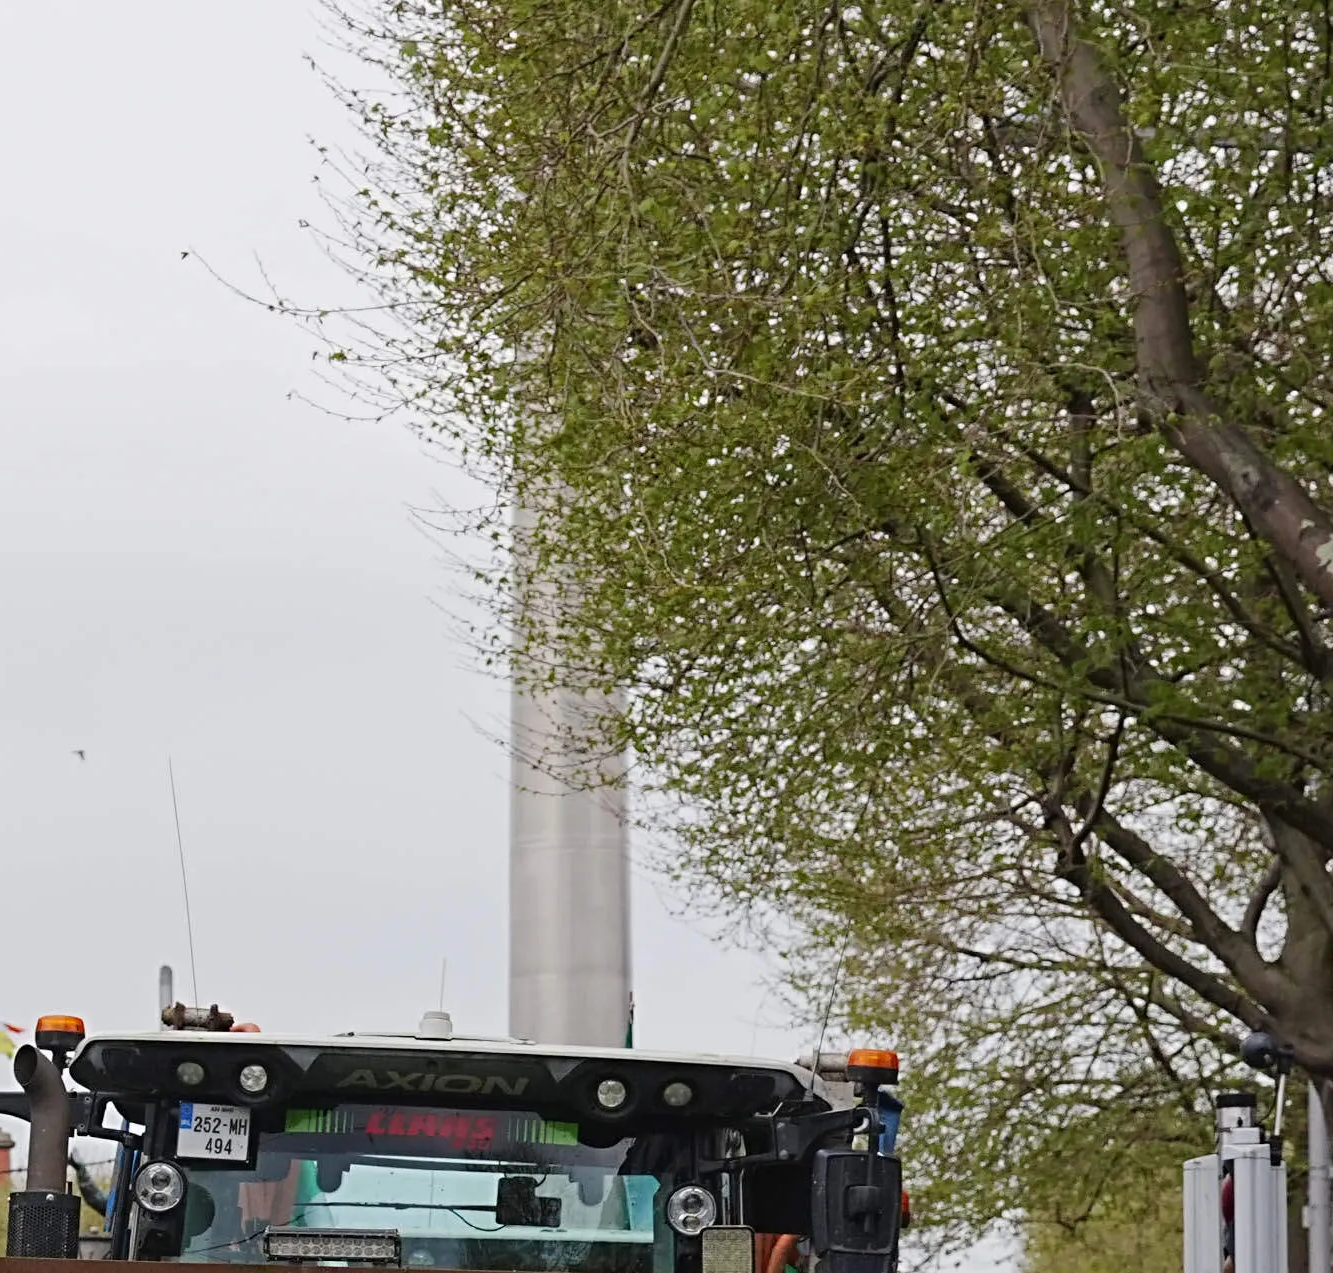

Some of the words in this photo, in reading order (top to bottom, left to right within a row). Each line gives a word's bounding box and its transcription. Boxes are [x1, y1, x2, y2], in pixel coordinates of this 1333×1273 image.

[336, 1068, 530, 1096] AXION
[193, 1116, 248, 1136] 252-MH
[204, 1137, 232, 1155] 494
